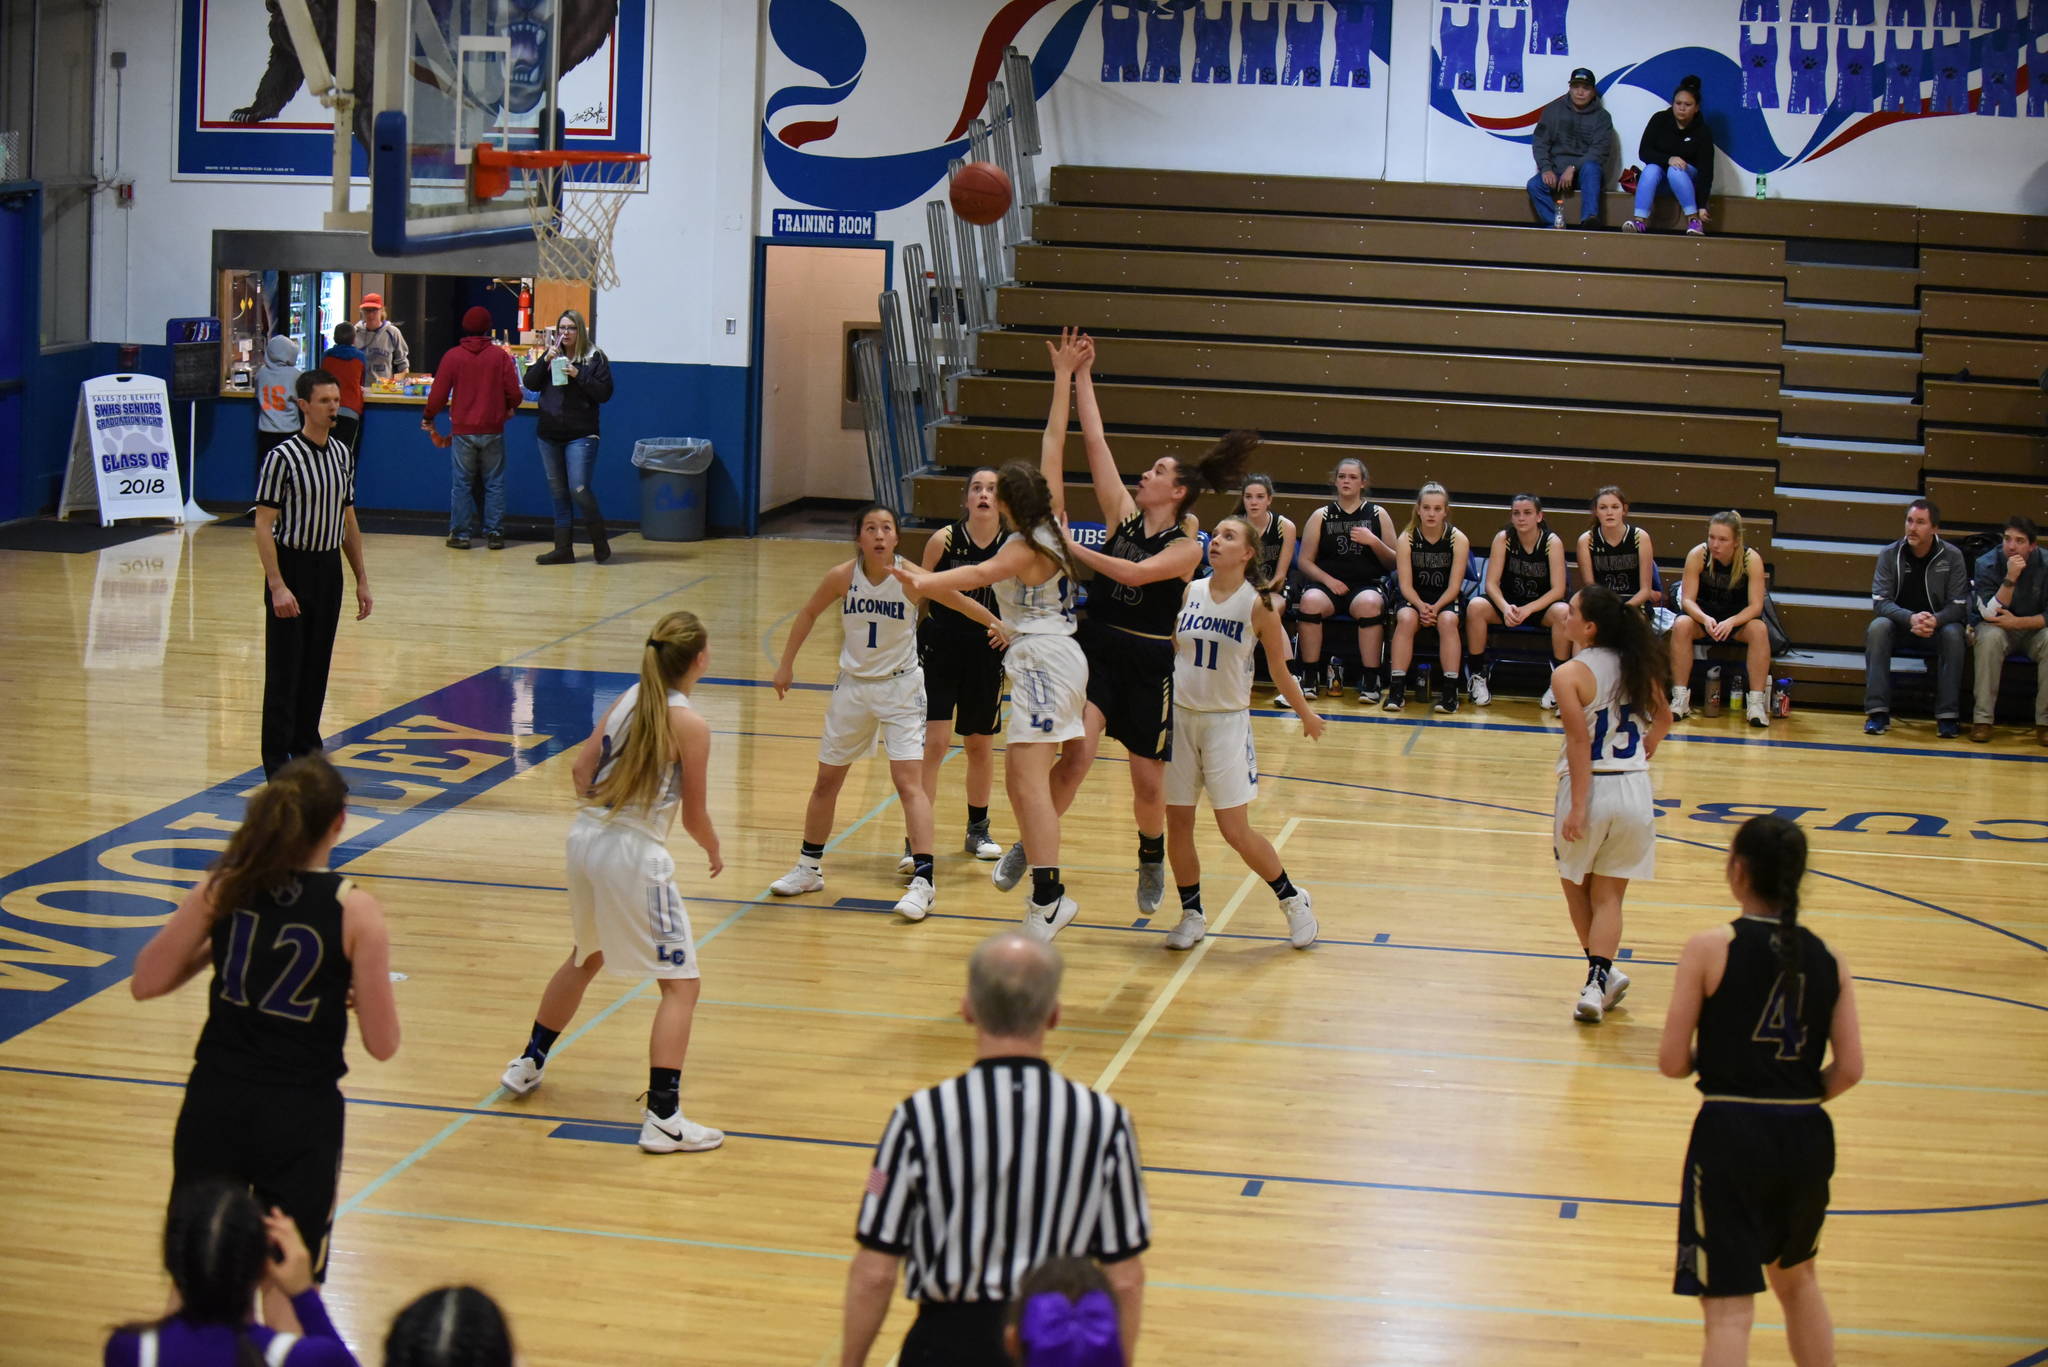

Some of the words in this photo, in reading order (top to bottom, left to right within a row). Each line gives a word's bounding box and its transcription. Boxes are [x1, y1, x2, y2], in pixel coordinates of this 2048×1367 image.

[777, 213, 834, 234] TRAINING
[838, 216, 872, 235] ROOM
[92, 394, 115, 402] SALES
[118, 394, 127, 402] TO
[130, 393, 161, 401] BENEFIT
[261, 384, 287, 411] 16
[94, 403, 122, 418] SWHS
[122, 402, 162, 416] SENIORS
[96, 416, 140, 431] GRADUATION
[141, 416, 163, 428] NIGHT
[101, 453, 150, 474] CLASS
[151, 452, 170, 471] OF
[119, 479, 165, 495] 2018
[1070, 528, 1107, 545] UBS
[843, 596, 905, 620] LACONNER
[866, 621, 877, 648] 1
[1178, 612, 1244, 643] LACONNER
[1192, 637, 1219, 671] 11
[1030, 713, 1053, 733] LC
[1590, 703, 1640, 760] 15
[1653, 798, 2048, 843] CUB
[220, 908, 324, 1022] 12
[655, 944, 686, 967] LC
[1751, 970, 1808, 1061] 4
